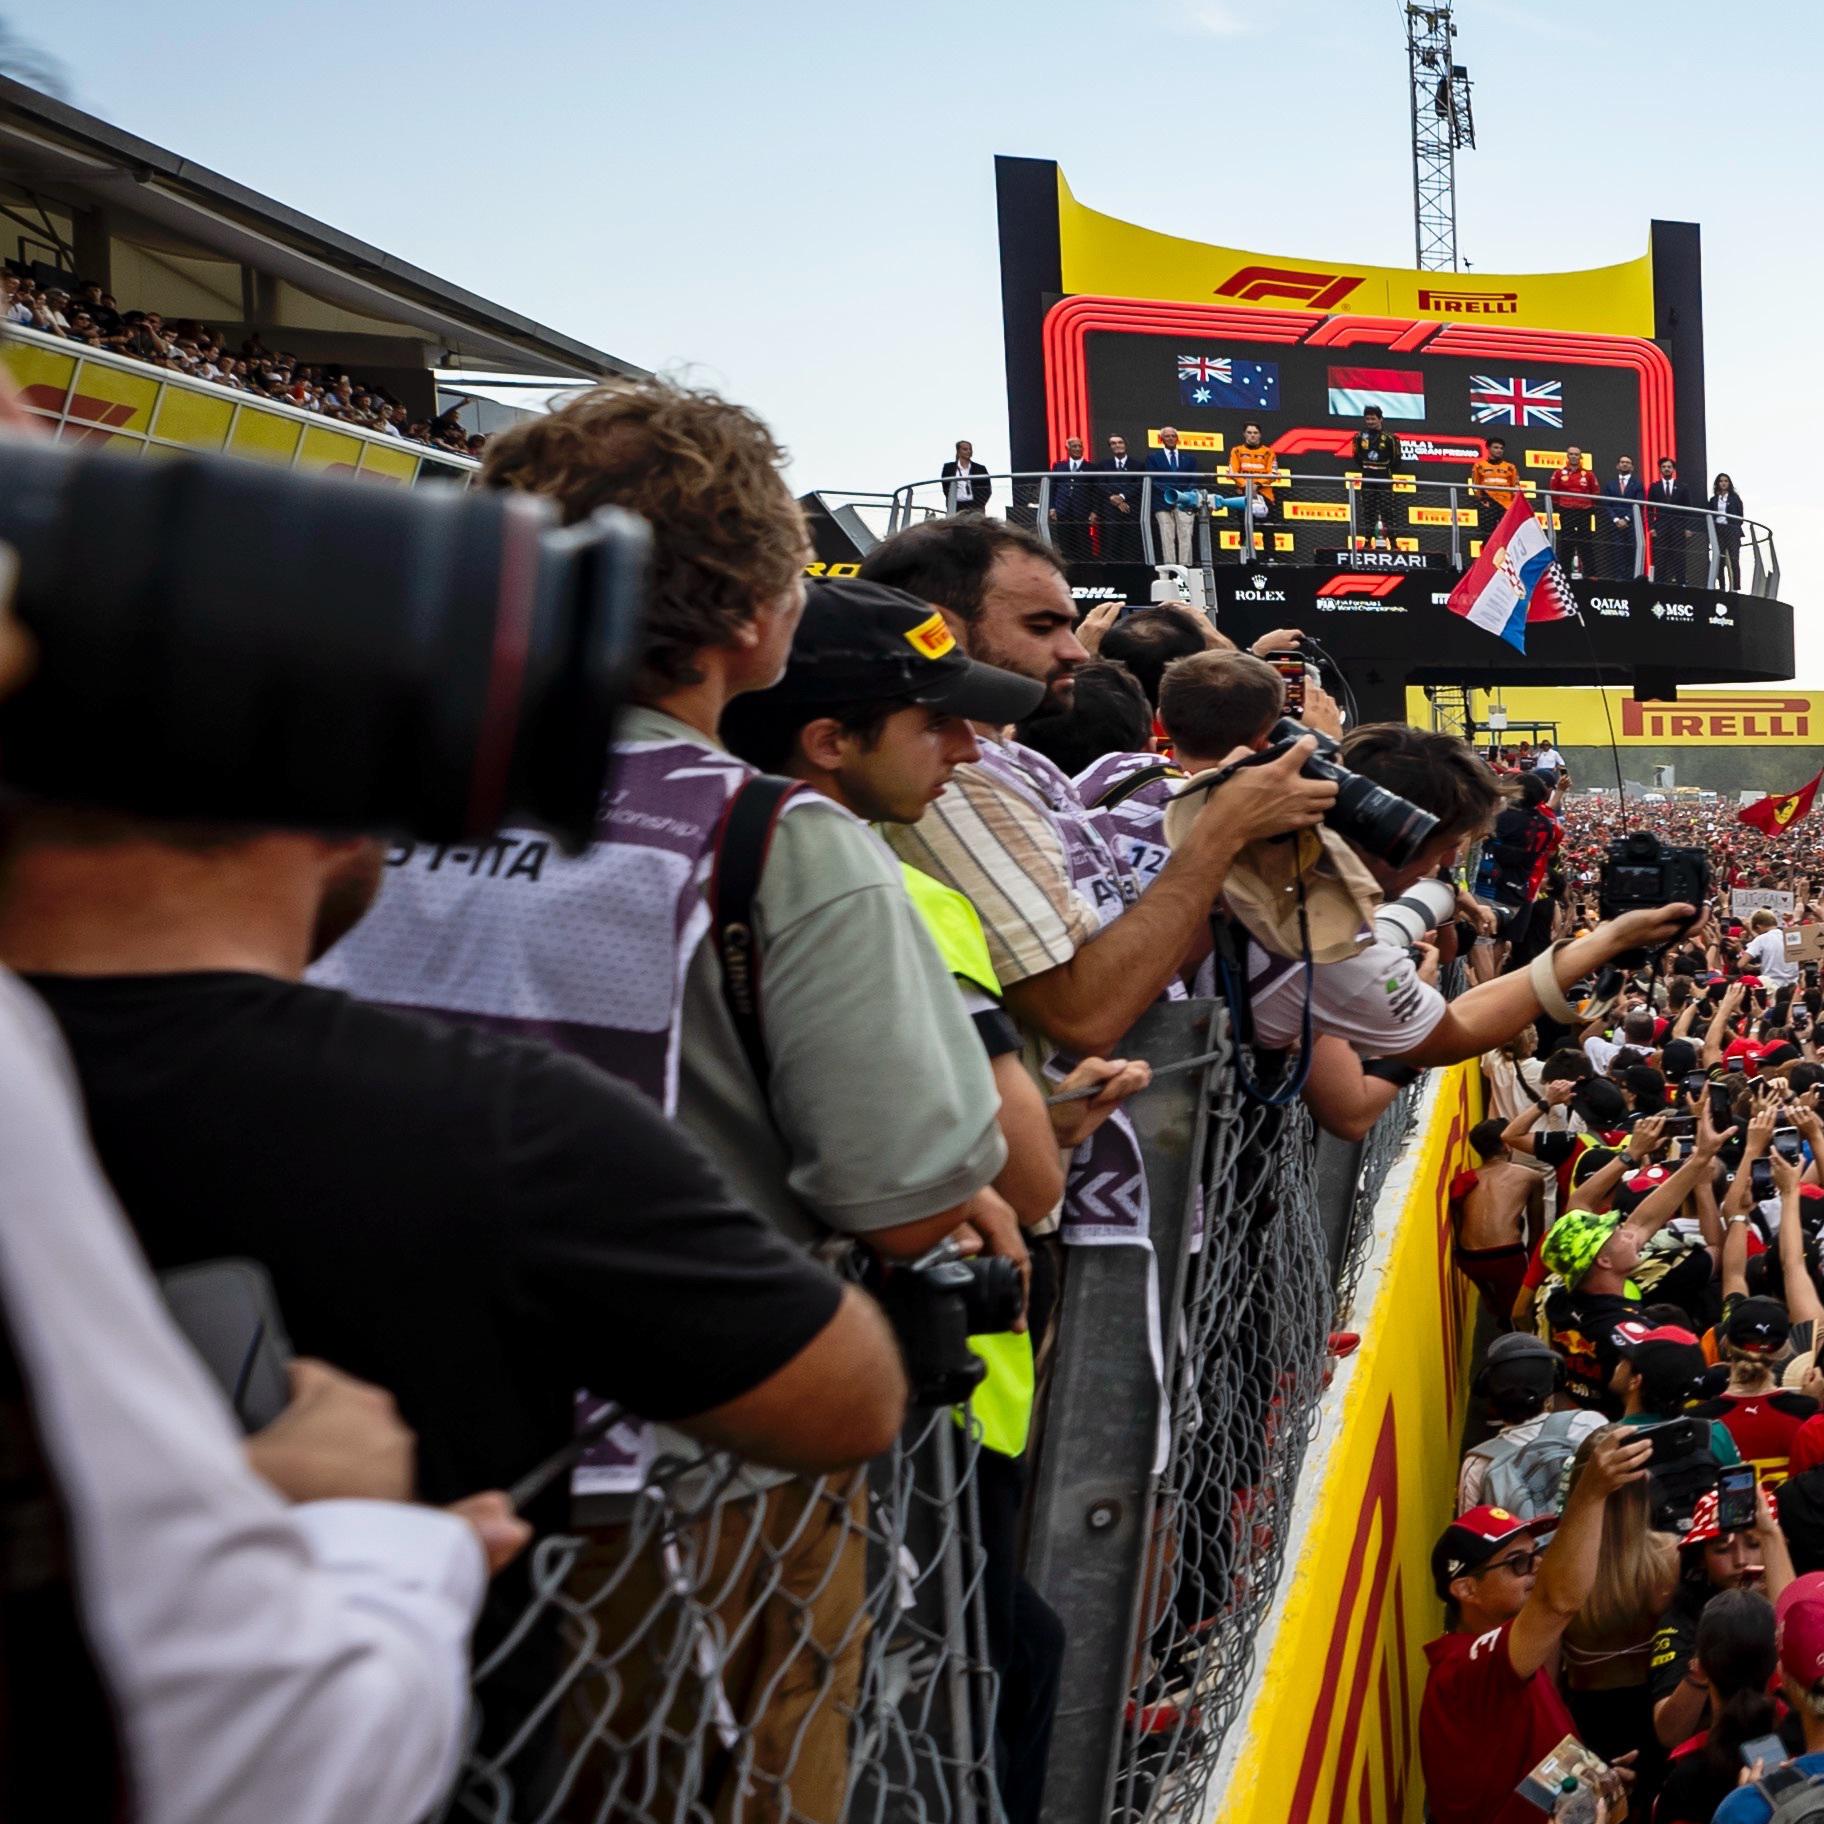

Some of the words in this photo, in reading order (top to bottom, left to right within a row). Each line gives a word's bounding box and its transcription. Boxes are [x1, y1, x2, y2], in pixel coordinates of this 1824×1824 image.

[1418, 289, 1518, 313] PIRELLI
[1337, 552, 1428, 568] FERRARI
[804, 562, 862, 578] RO
[1071, 587, 1117, 599] DHL
[1235, 590, 1286, 601] ROLEX
[1316, 598, 1337, 612] FIA
[1590, 597, 1629, 611] QATAR
[1666, 603, 1694, 617] MSC
[1622, 697, 1811, 737] PIRELLI
[1129, 845, 1166, 874] 12
